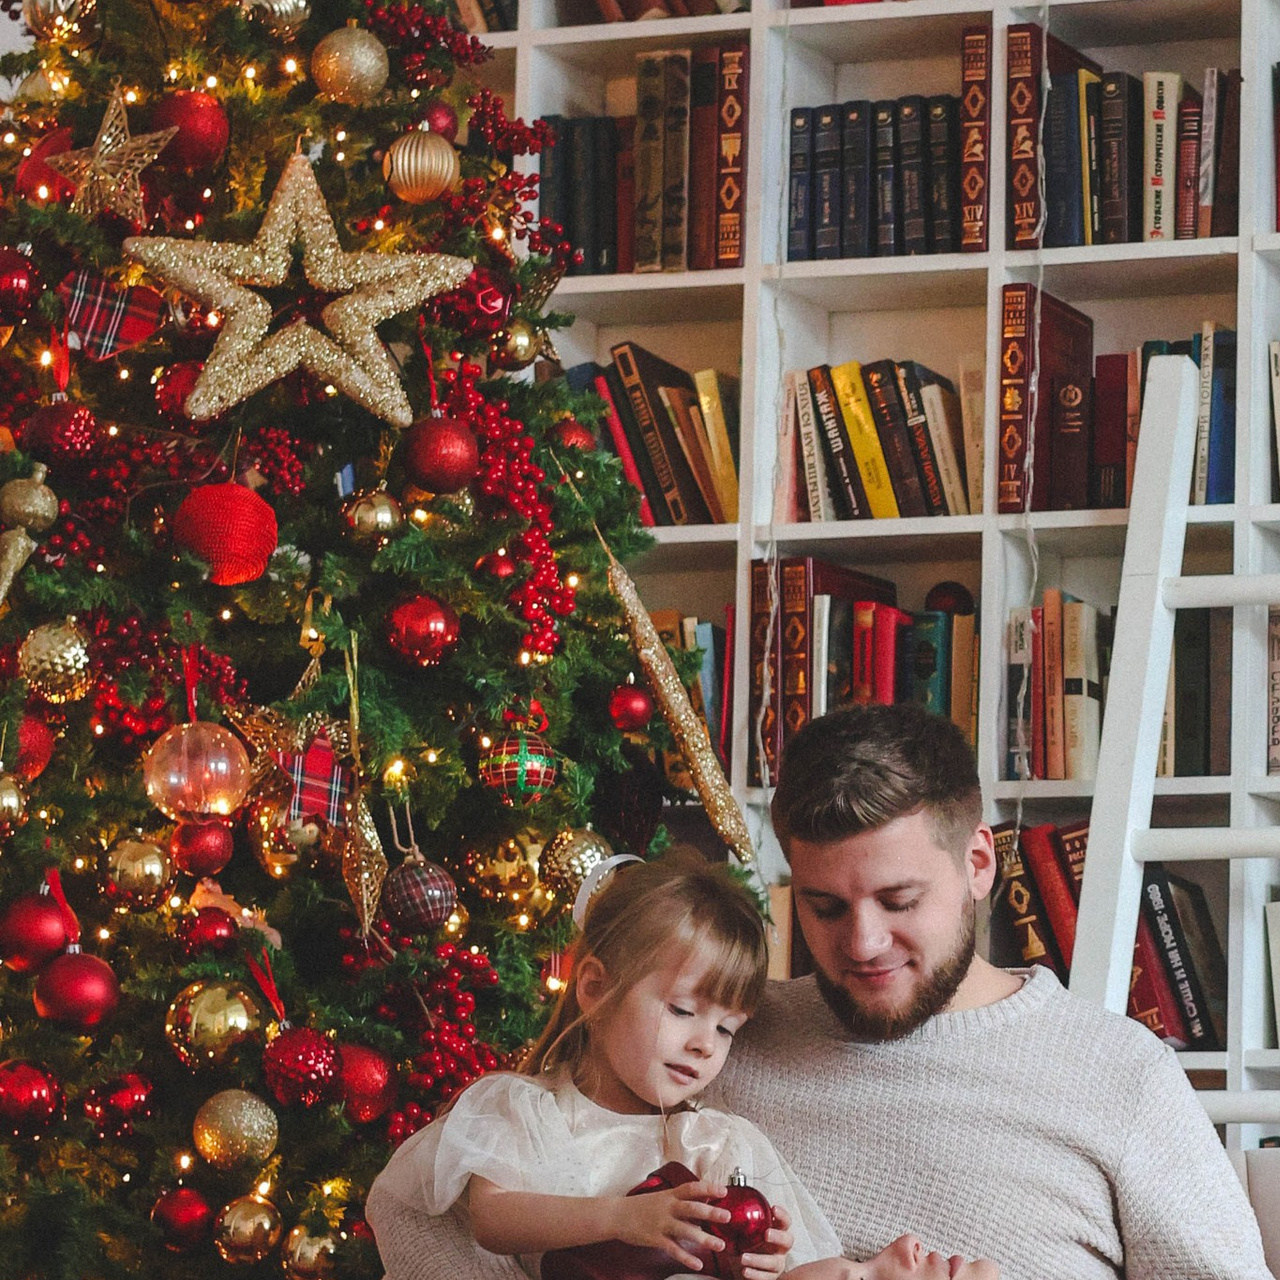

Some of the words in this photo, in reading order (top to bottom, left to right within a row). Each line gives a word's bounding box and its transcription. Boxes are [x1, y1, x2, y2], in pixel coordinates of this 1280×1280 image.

[1152, 80, 1166, 119] ПОВЕСТИ
[1151, 123, 1165, 185] ИСТОРИЧЕСКИЕ
[963, 205, 983, 221] XIV
[1015, 202, 1035, 220] XIV
[1199, 334, 1212, 406] ТОЛСТЯКА
[815, 389, 844, 453] ШАНТАЖ
[1198, 414, 1209, 440] ТРИ
[1004, 464, 1016, 481] IV
[1156, 913, 1176, 948] МОРЕ
[1168, 949, 1182, 967] НА
[1173, 967, 1186, 979] И
[1178, 979, 1198, 1017] СУШЕ
